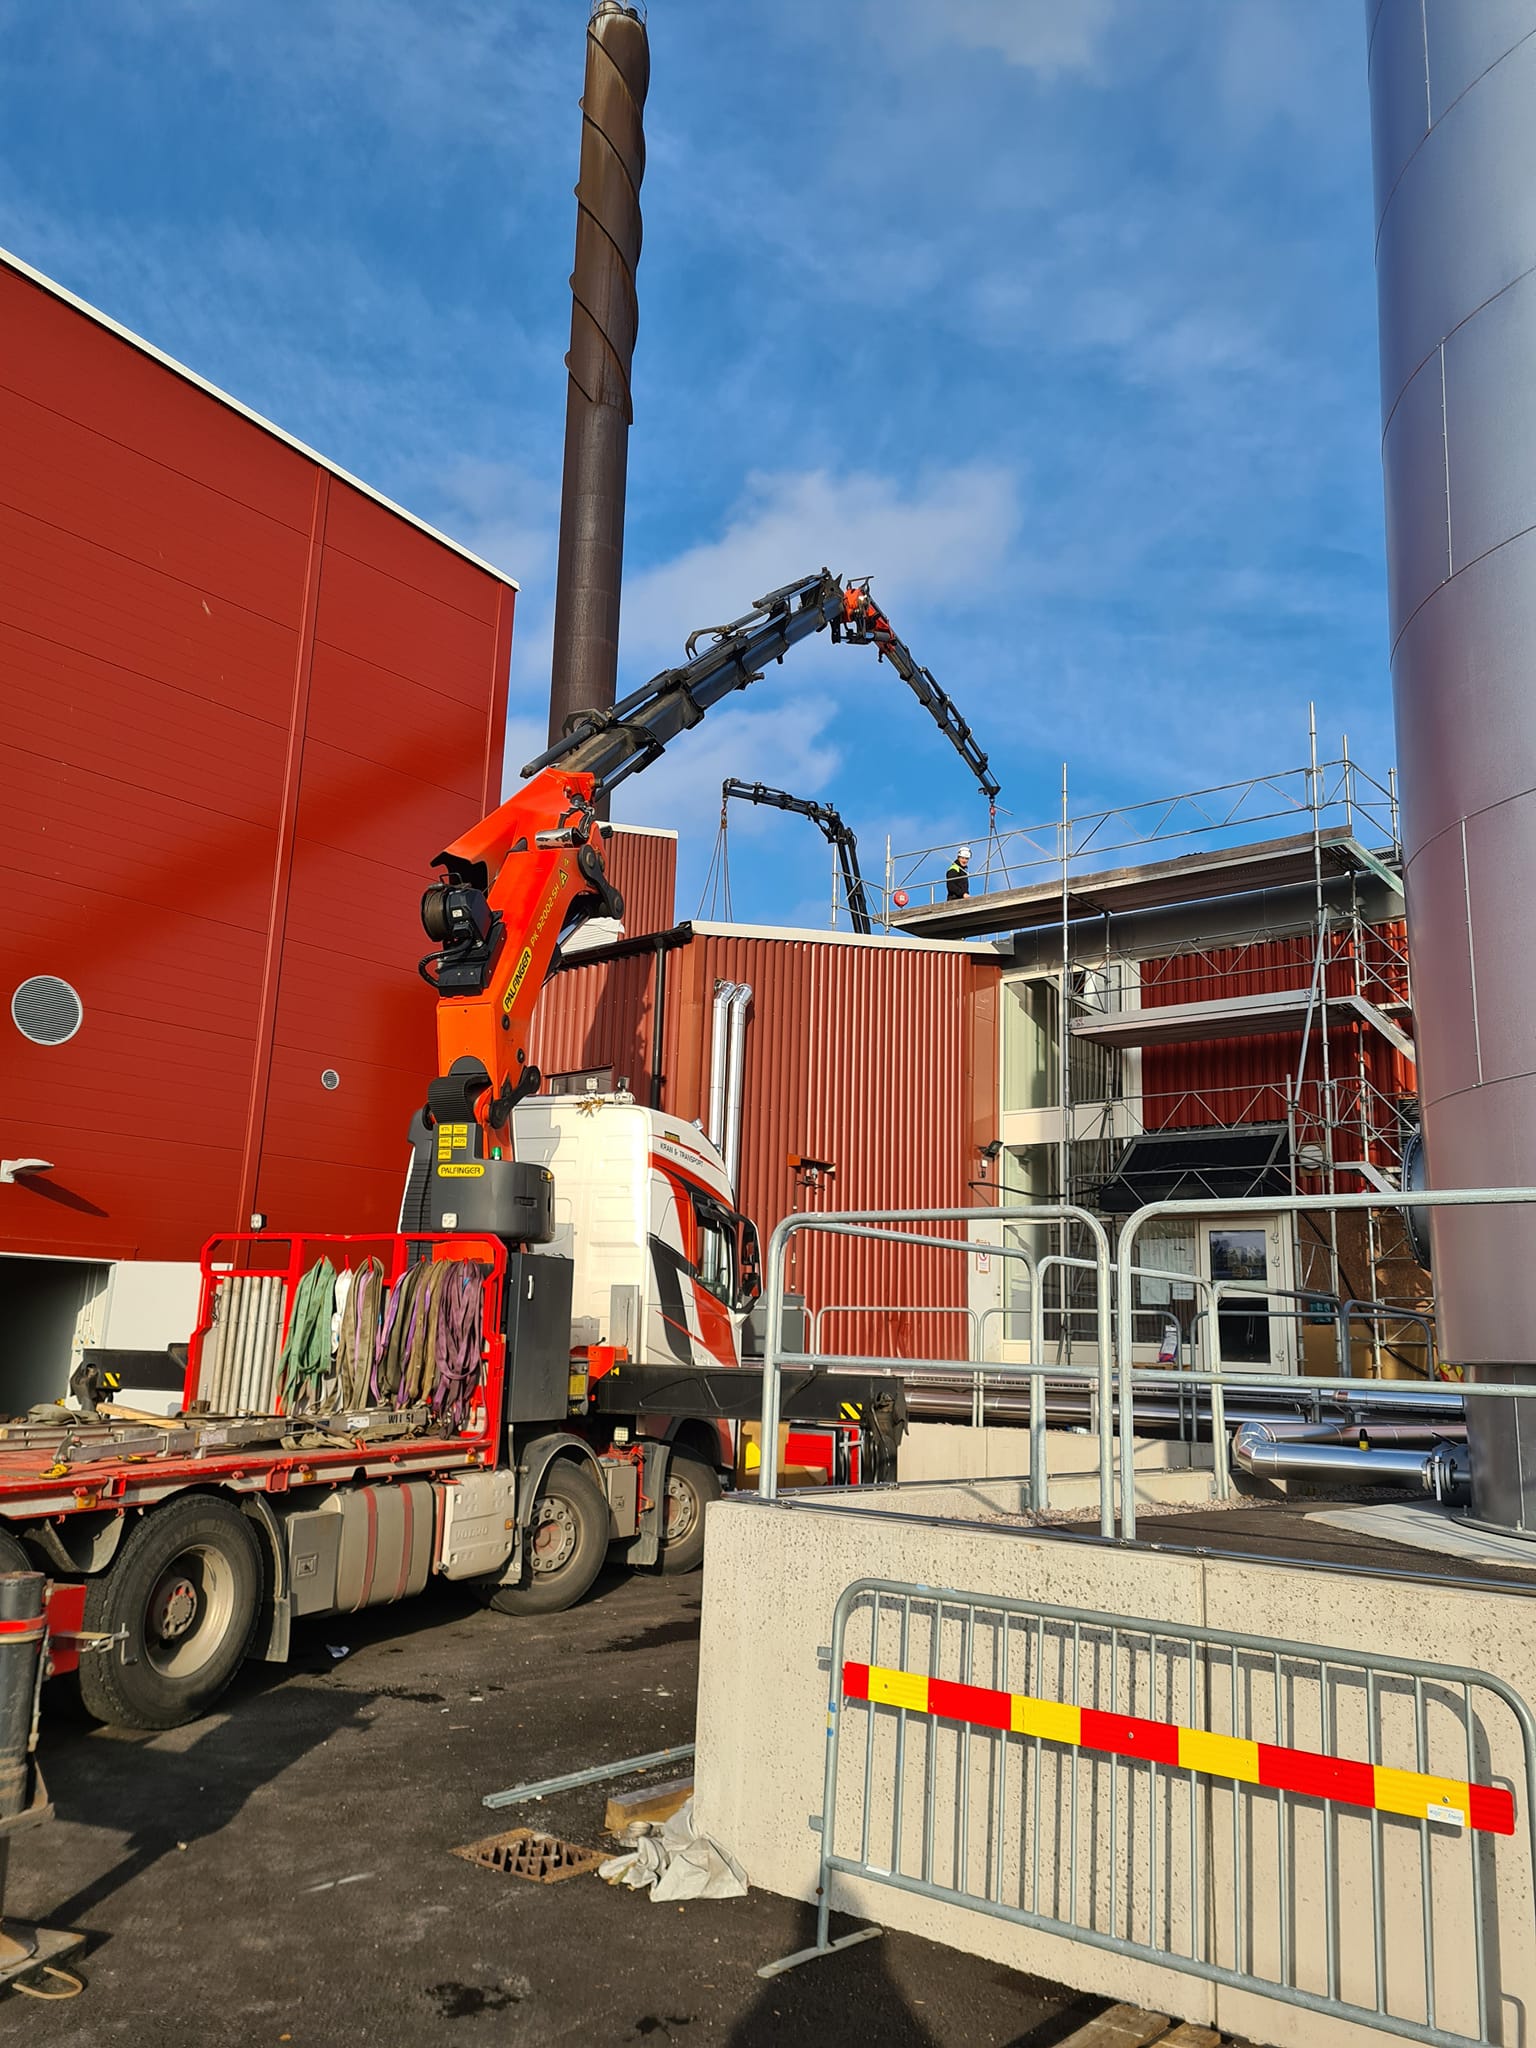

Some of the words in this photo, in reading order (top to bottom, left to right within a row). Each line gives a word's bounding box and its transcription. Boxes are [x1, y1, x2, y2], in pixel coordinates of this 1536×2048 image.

[504, 950, 531, 1009] PALFINGER
[530, 934, 540, 946] PK
[440, 1166, 481, 1175] PALFINGER
